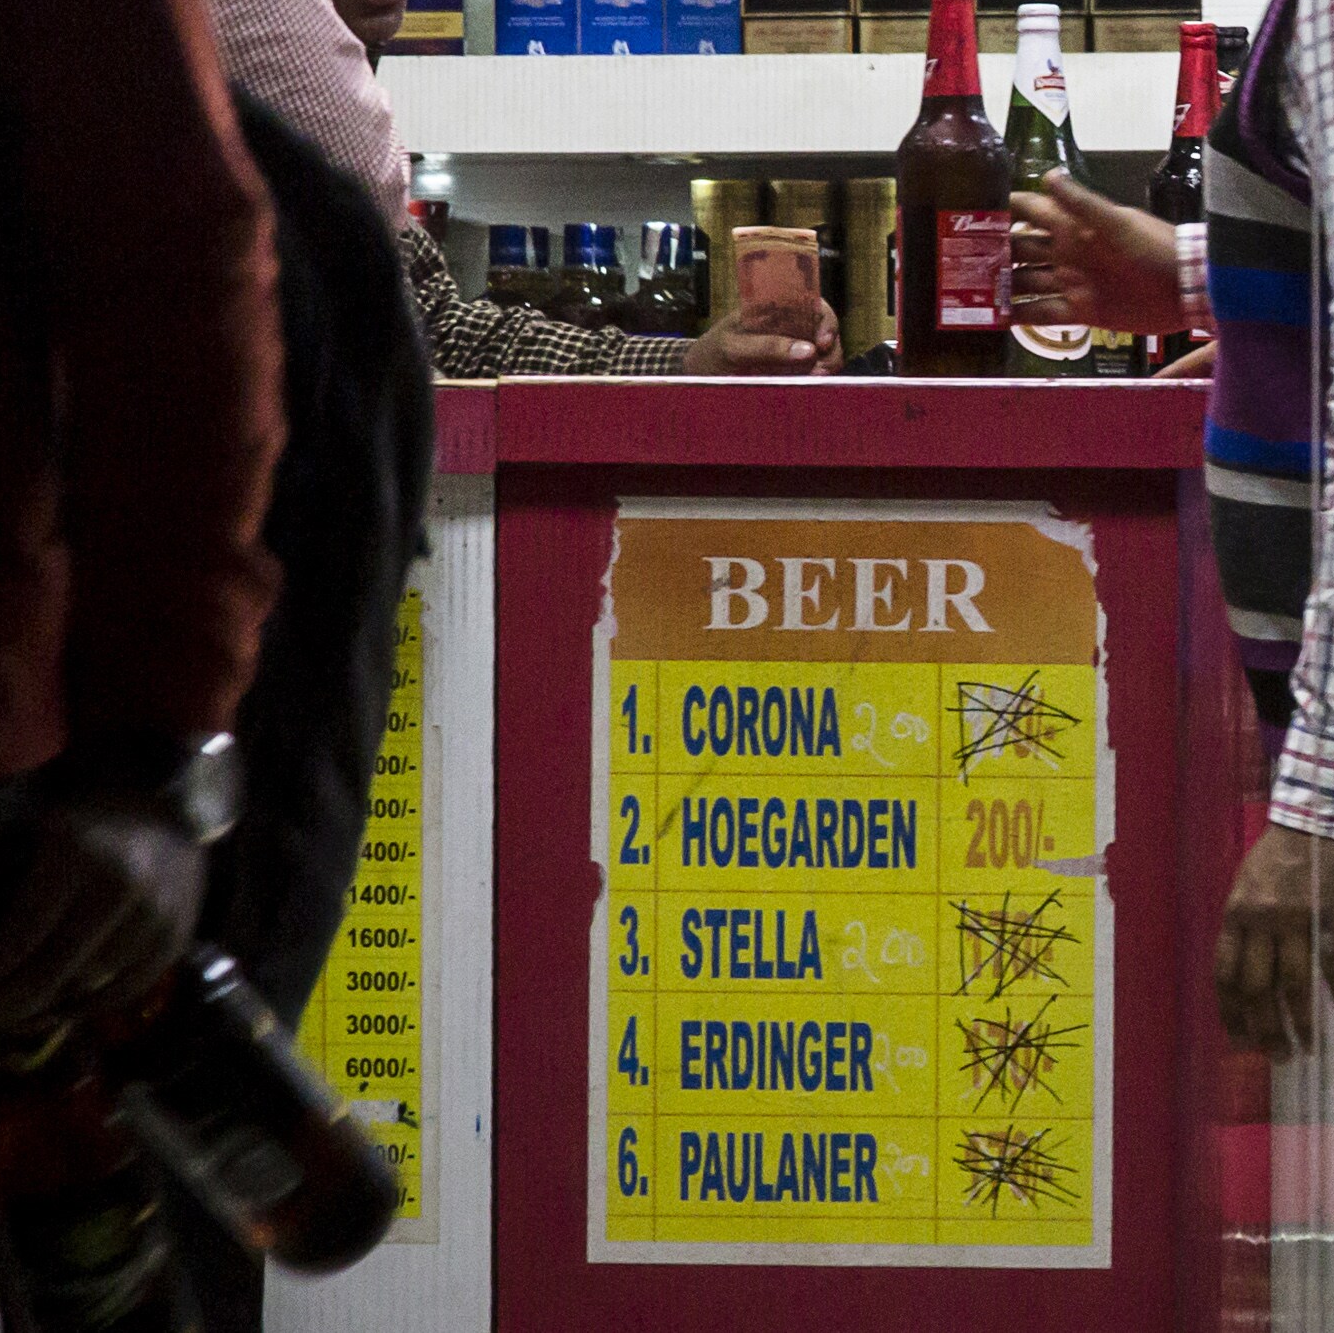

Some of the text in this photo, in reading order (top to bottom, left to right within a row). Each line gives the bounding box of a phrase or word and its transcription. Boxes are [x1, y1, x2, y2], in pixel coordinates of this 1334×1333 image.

[703, 556, 995, 633] BEER
[620, 684, 841, 757] 1. CORONA
[619, 794, 1056, 869] 2. HOEGARDEN 200/-
[349, 885, 416, 906] 1400/-
[347, 928, 416, 949] 1600/-
[619, 904, 650, 976] 3.
[680, 908, 823, 980] STELLA
[346, 971, 415, 992] 3000/-
[346, 1014, 415, 1035] 3000/-
[617, 1015, 649, 1086] 4.
[680, 1020, 874, 1092] ERDINGER
[345, 1057, 415, 1079] 6000/-
[617, 1126, 649, 1197] 6.
[679, 1131, 878, 1203] PAULANER
